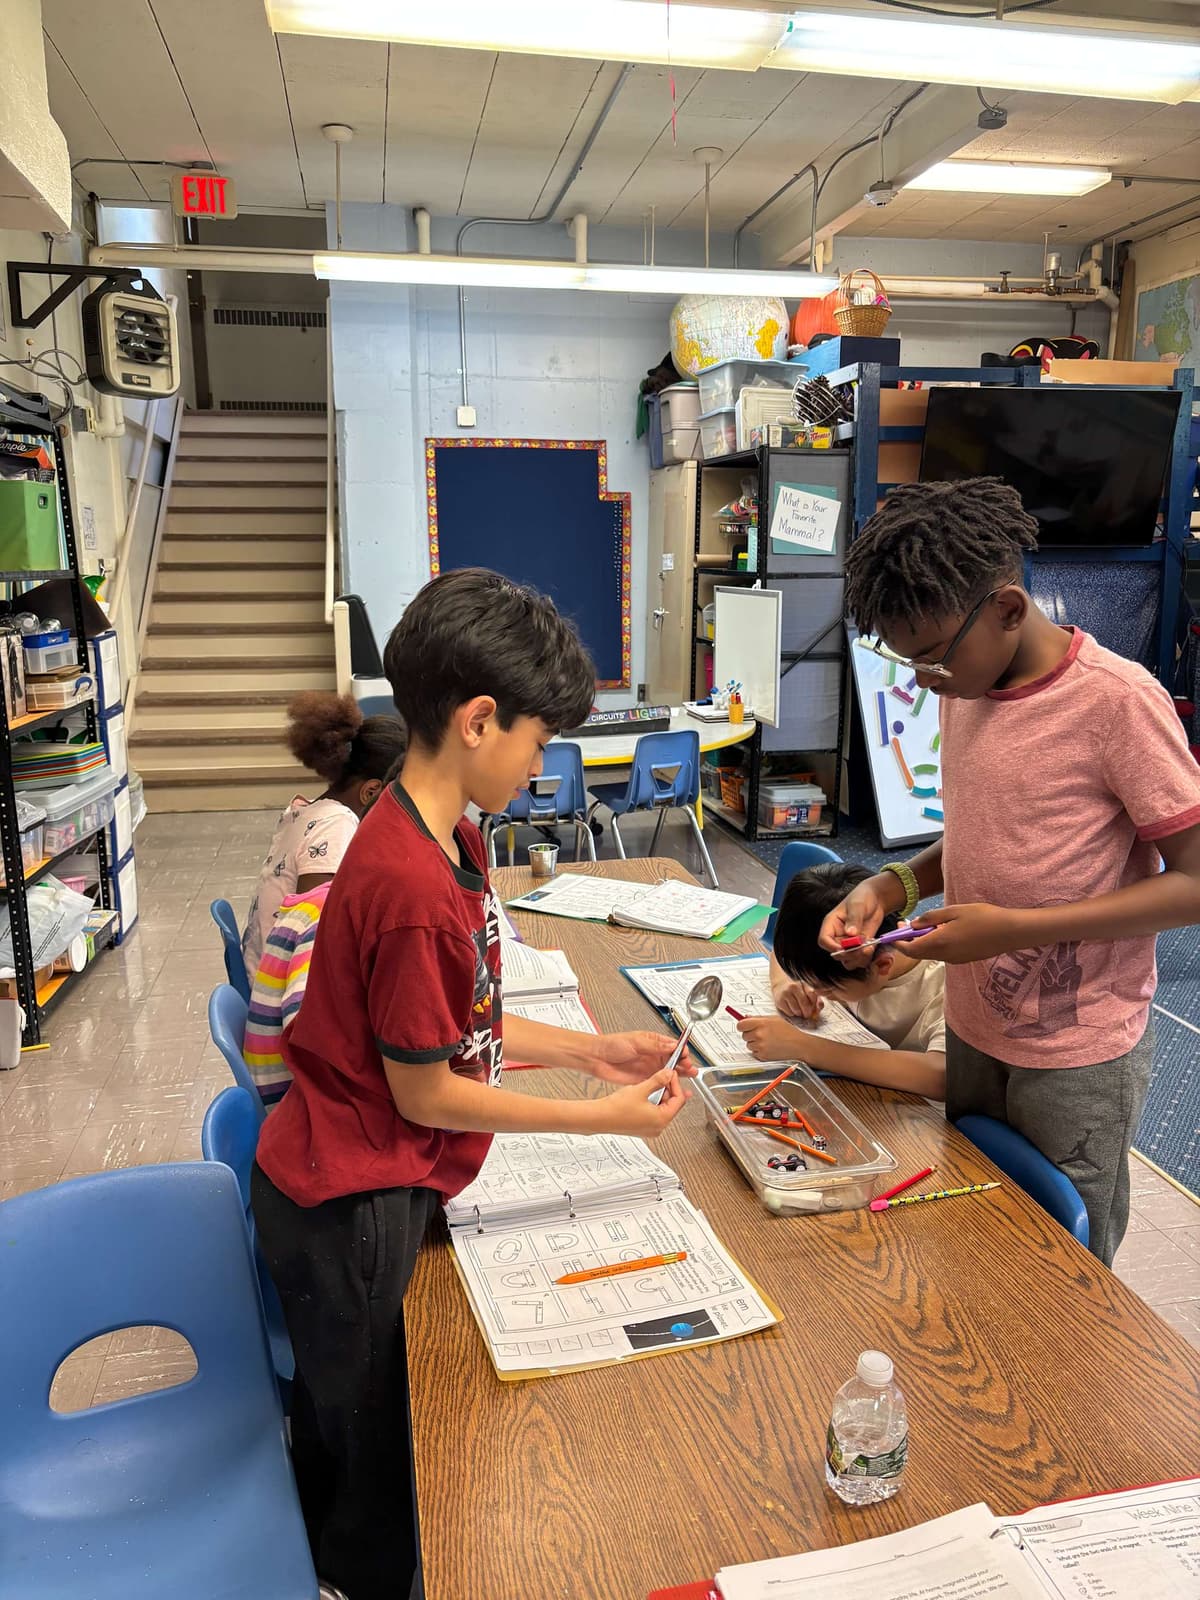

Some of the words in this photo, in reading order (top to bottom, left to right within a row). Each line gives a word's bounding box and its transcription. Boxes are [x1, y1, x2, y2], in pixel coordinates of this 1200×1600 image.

[182, 176, 228, 214] EXIT
[782, 489, 800, 508] What
[812, 499, 828, 513] Your
[792, 509, 817, 524] Favorite
[1124, 1506, 1165, 1521] Week
[1162, 1503, 1194, 1516] Nine
[942, 1579, 965, 1588] magnets
[986, 1573, 1003, 1582] nearly
